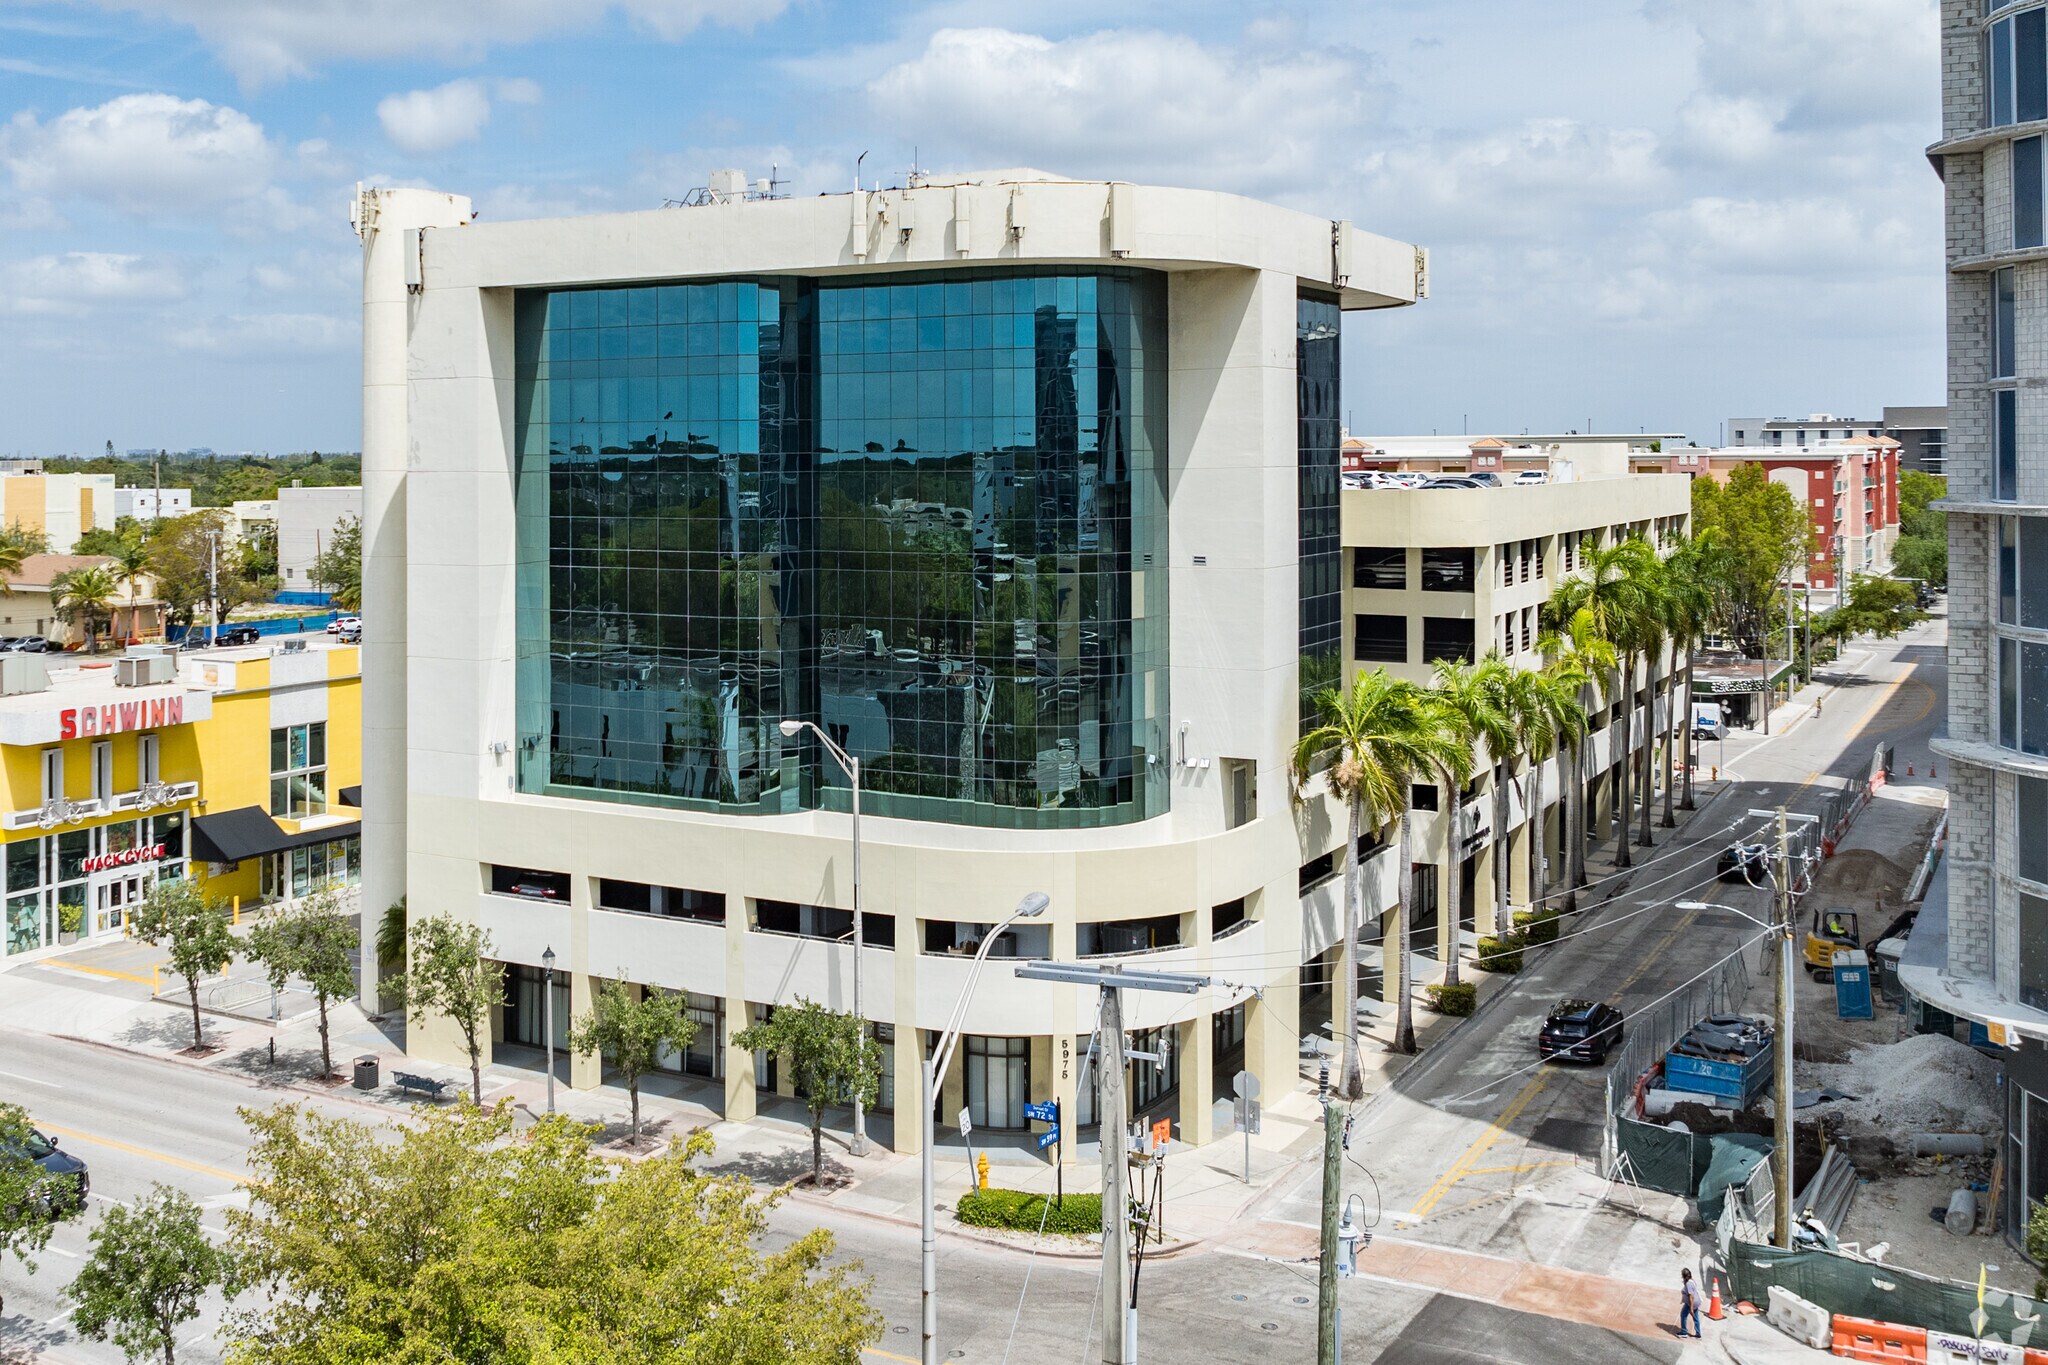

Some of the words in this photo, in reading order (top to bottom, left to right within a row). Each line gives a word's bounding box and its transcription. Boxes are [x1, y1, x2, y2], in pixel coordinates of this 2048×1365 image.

[60, 695, 183, 740] SCHWINN
[81, 852, 121, 872] MACK
[124, 843, 166, 863] CYCLE
[1061, 1039, 1069, 1079] 5975
[962, 1120, 970, 1133] 20
[1027, 1110, 1035, 1118] SW
[1036, 1111, 1046, 1120] 72
[1048, 1113, 1054, 1121] St
